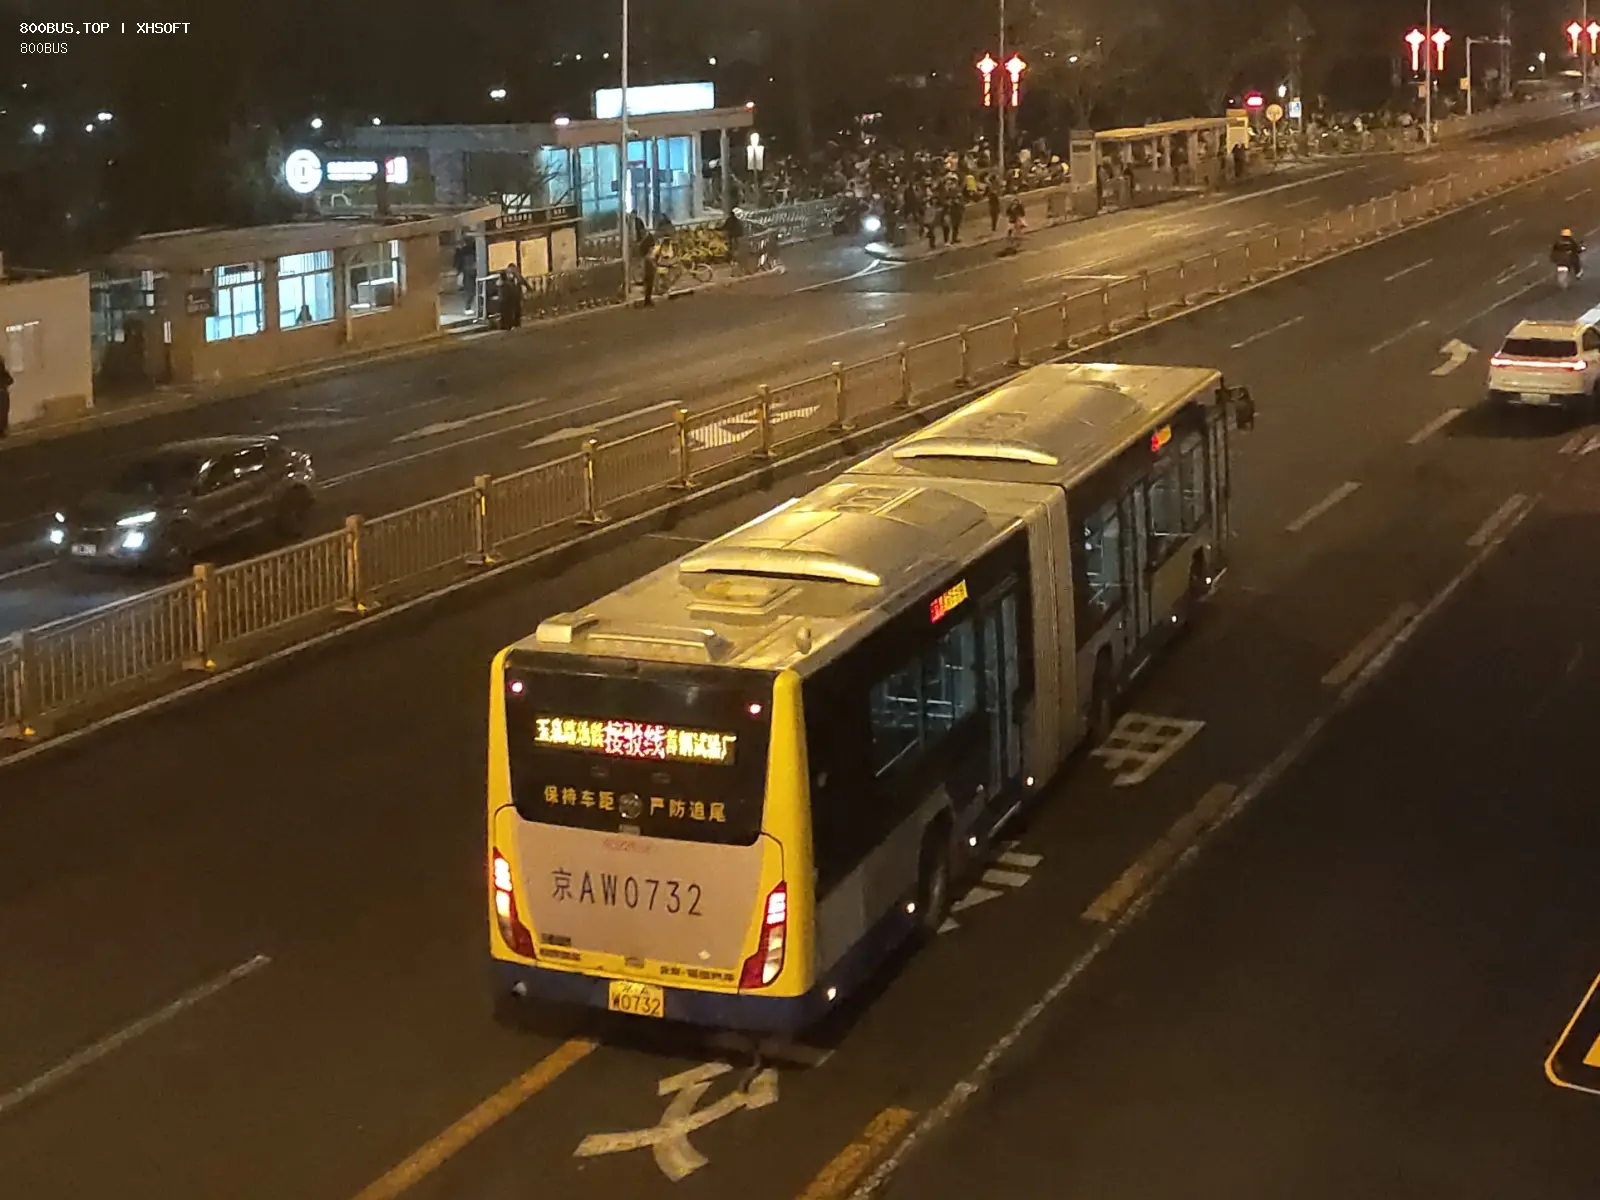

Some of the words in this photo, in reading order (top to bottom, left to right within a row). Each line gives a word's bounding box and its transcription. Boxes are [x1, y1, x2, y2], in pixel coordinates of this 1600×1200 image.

[544, 785, 615, 811] 保持车距
[650, 797, 727, 823] 严防追尾
[551, 867, 702, 917] 京AW0732
[612, 992, 661, 1016] W0732
